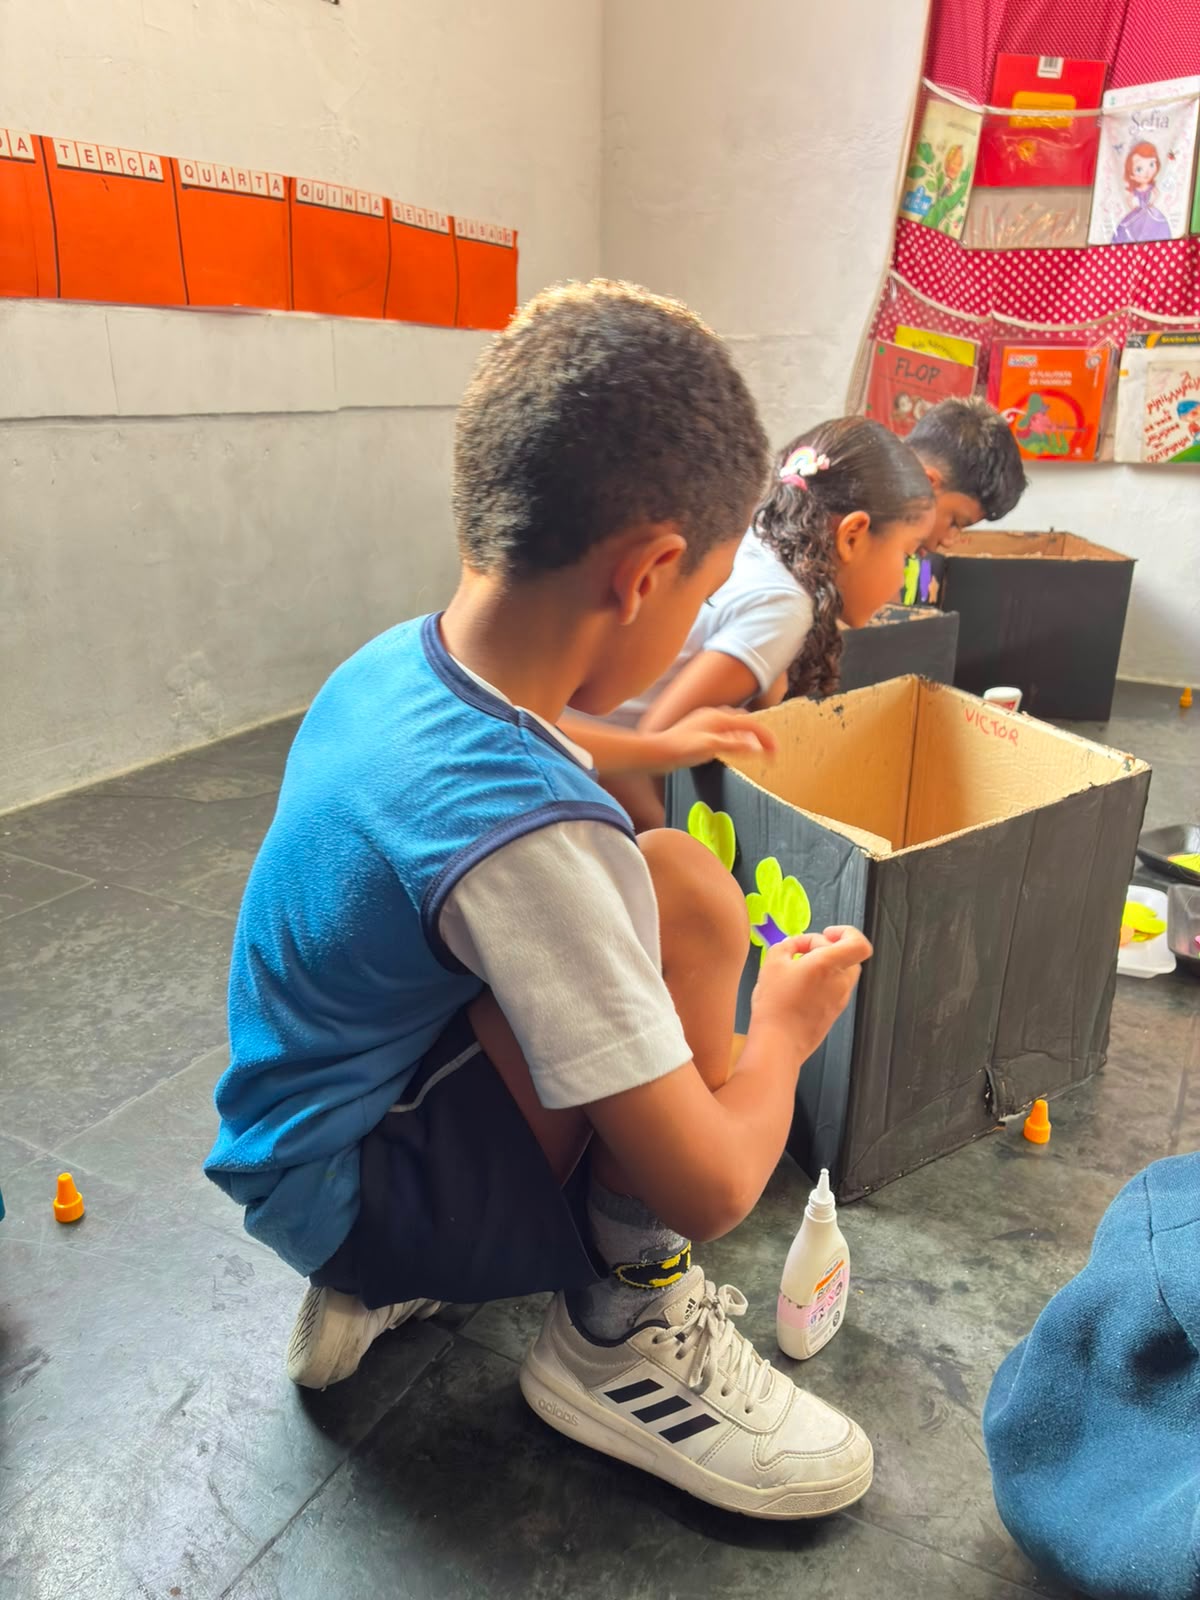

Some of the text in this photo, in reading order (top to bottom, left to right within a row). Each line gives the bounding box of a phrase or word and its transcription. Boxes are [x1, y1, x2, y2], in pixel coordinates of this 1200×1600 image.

[1129, 109, 1170, 136] Sofia
[0, 137, 29, 153] A
[59, 144, 159, 175] TERÇA
[184, 164, 281, 194] QUARTA
[300, 183, 381, 212] QUINTA
[394, 206, 447, 228] SEXTA
[894, 357, 941, 385] FLOP
[964, 708, 1019, 746] VICTOR
[538, 1399, 578, 1427] adidas
